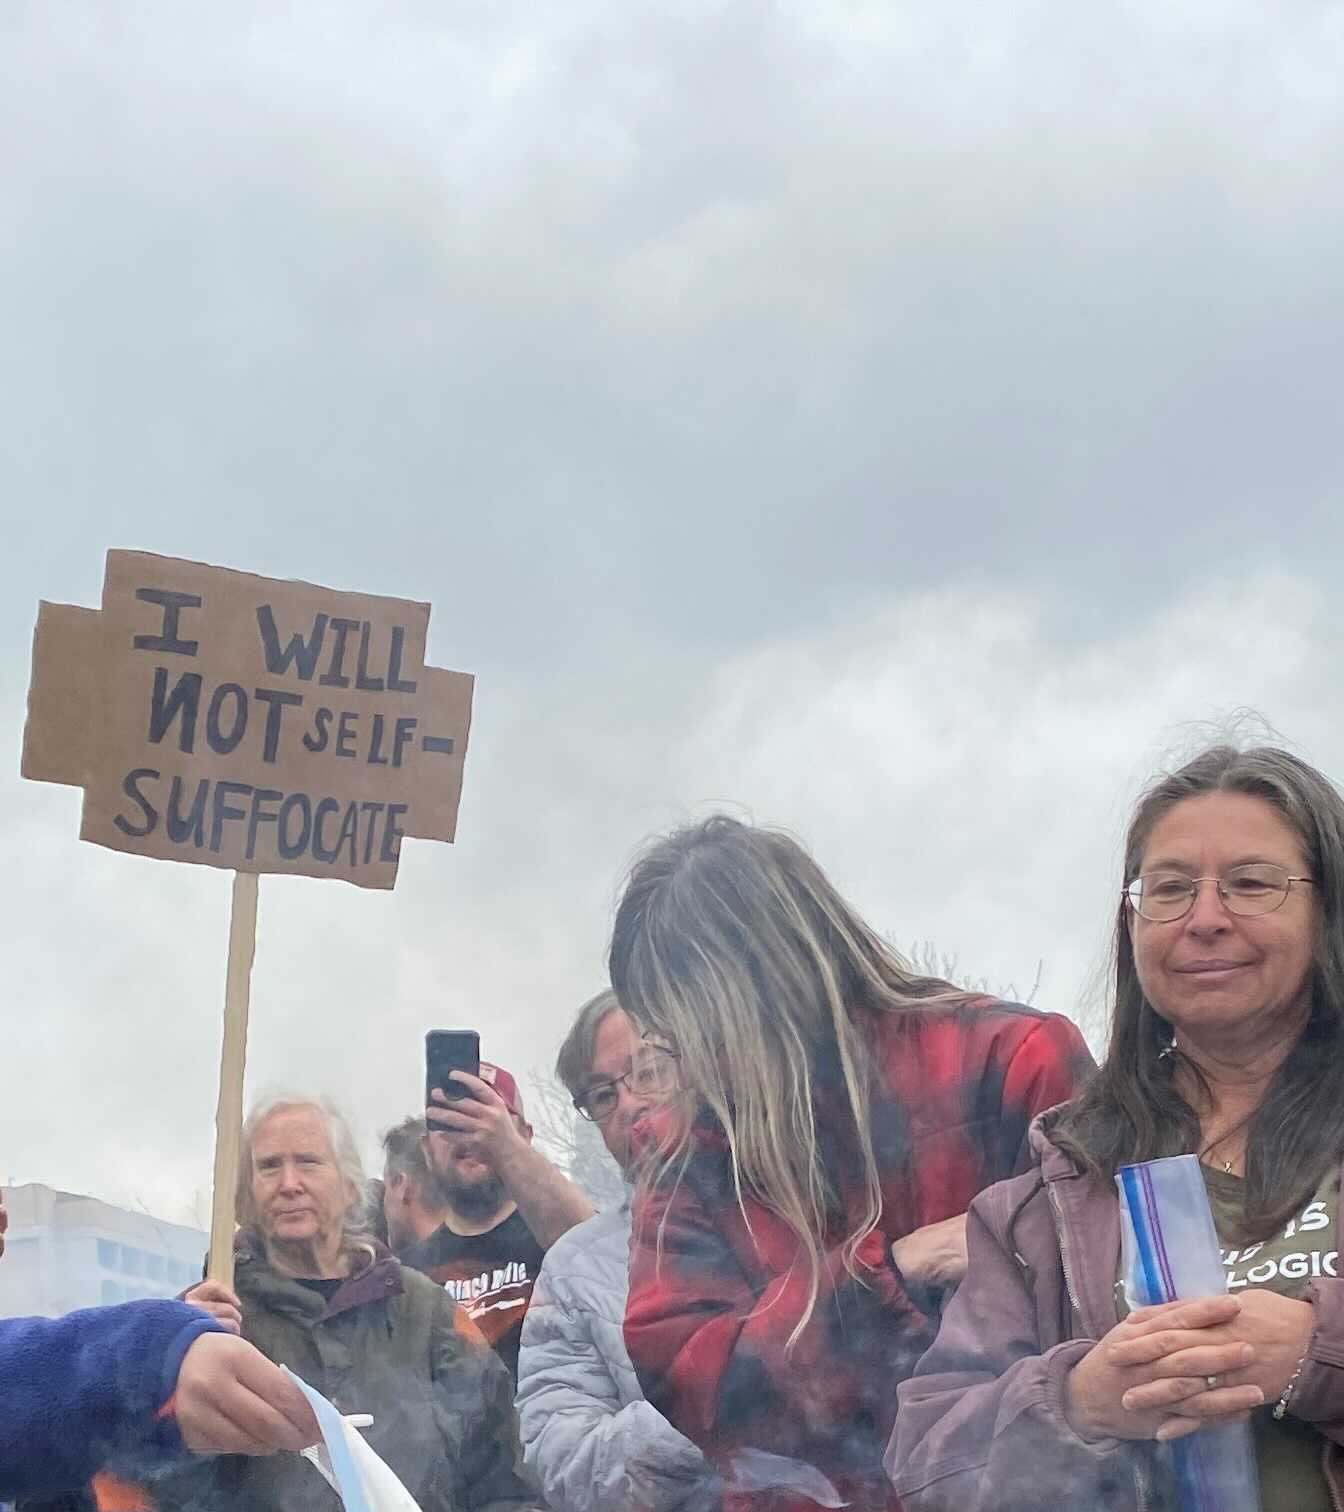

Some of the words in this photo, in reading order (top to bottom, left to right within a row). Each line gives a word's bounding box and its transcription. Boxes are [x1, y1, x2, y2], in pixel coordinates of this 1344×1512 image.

[134, 588, 202, 656] I
[256, 604, 417, 694] WILL
[148, 667, 304, 763] NOT
[301, 708, 454, 768] SELF-
[113, 768, 409, 866] SUFFOCATE
